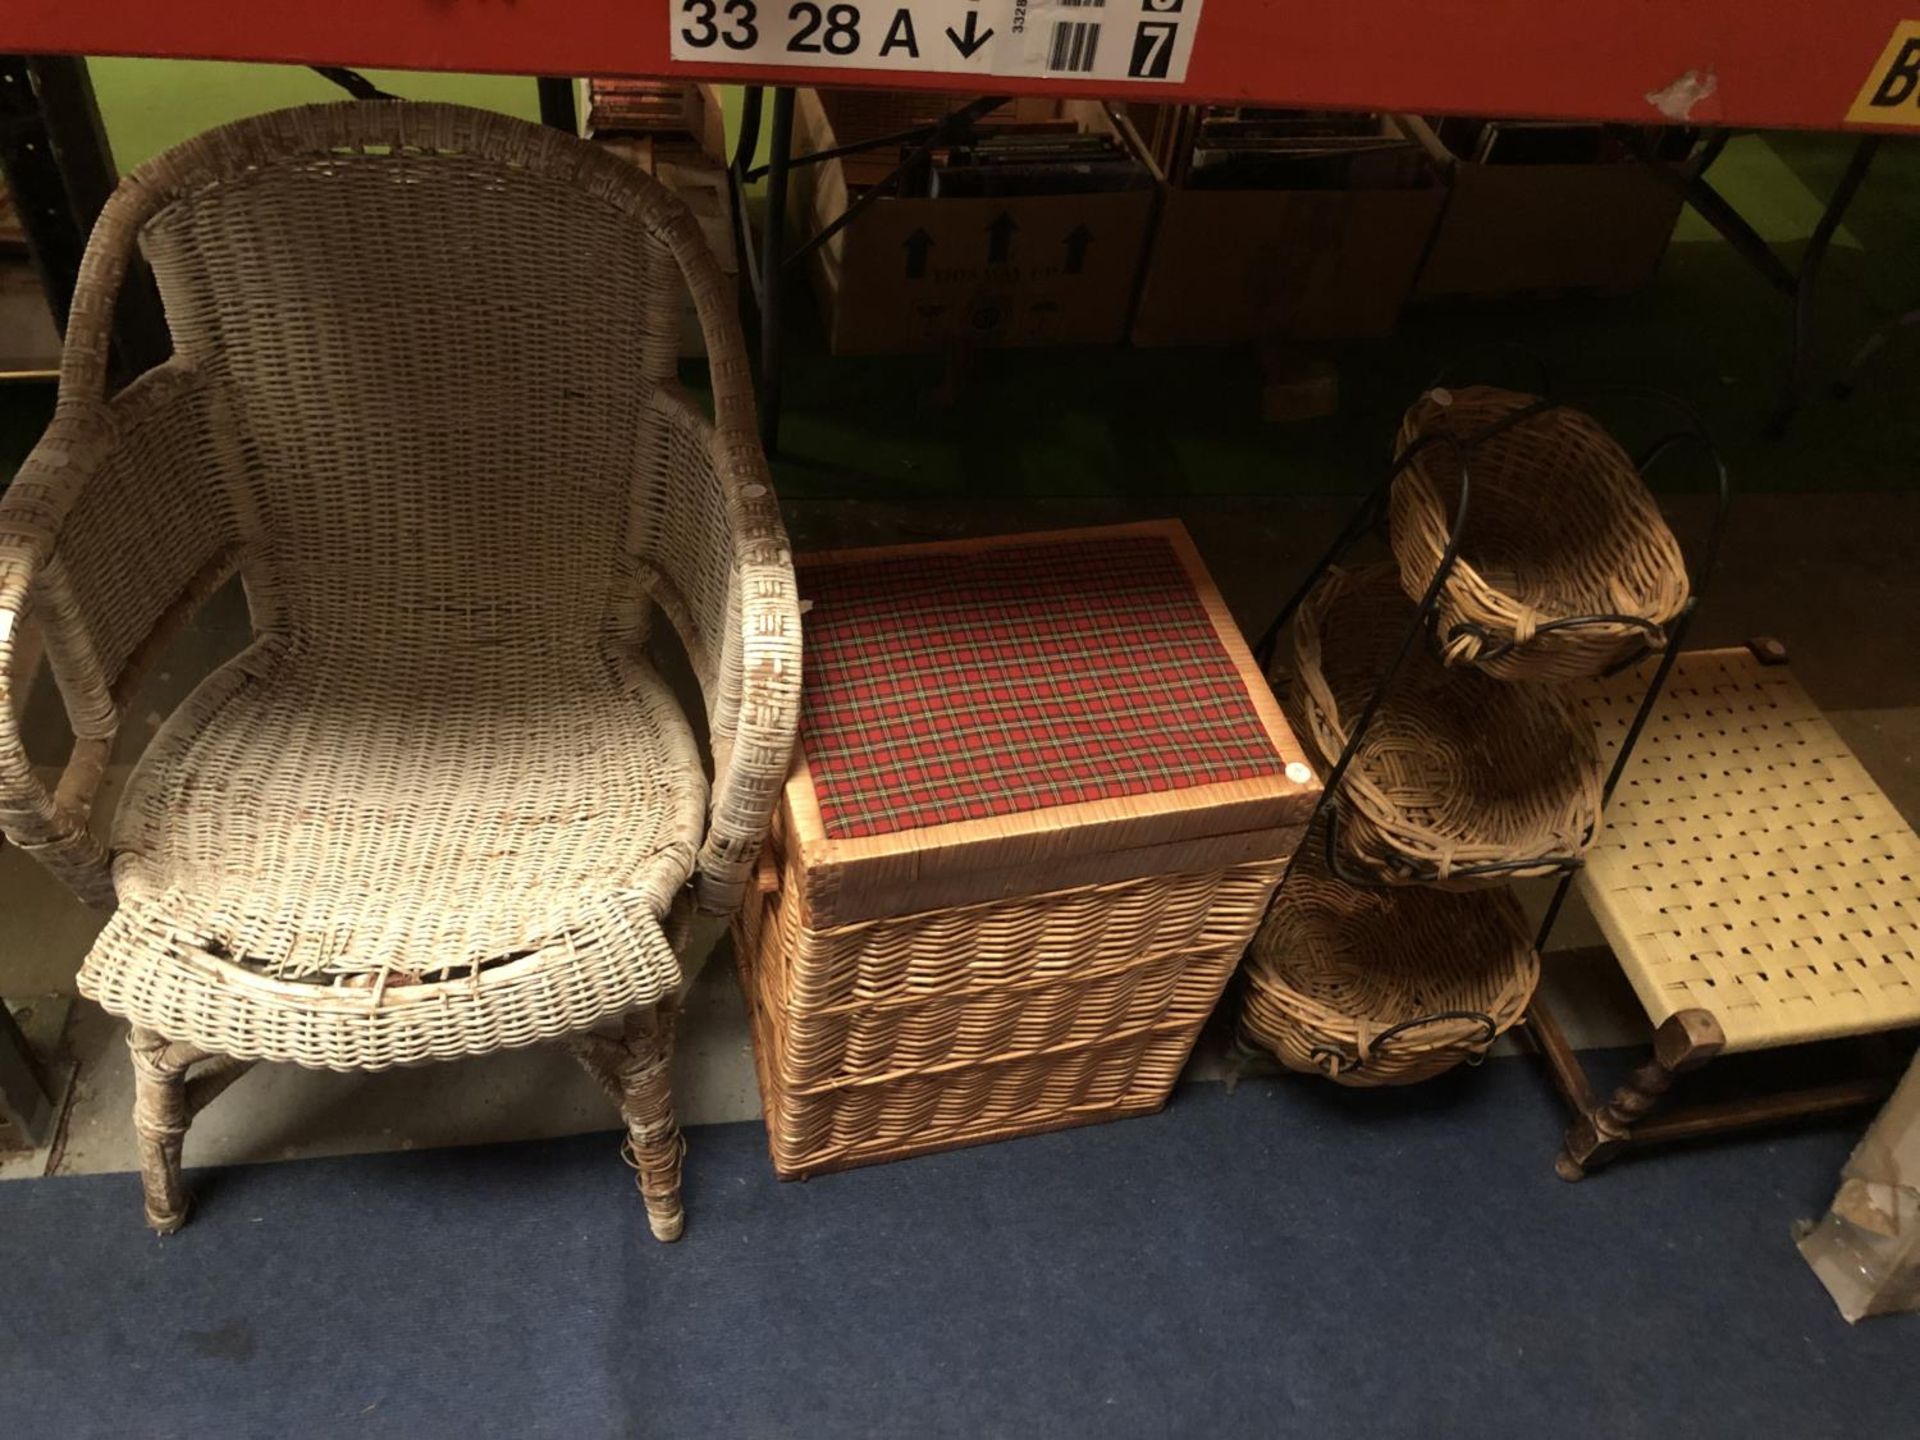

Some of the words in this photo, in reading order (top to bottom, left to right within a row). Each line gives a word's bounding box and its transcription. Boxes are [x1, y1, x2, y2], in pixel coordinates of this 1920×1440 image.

[681, 0, 759, 50] 33
[786, 2, 860, 55] 28
[879, 9, 919, 58] A
[1140, 26, 1170, 76] 7
[1869, 38, 1920, 108] B
